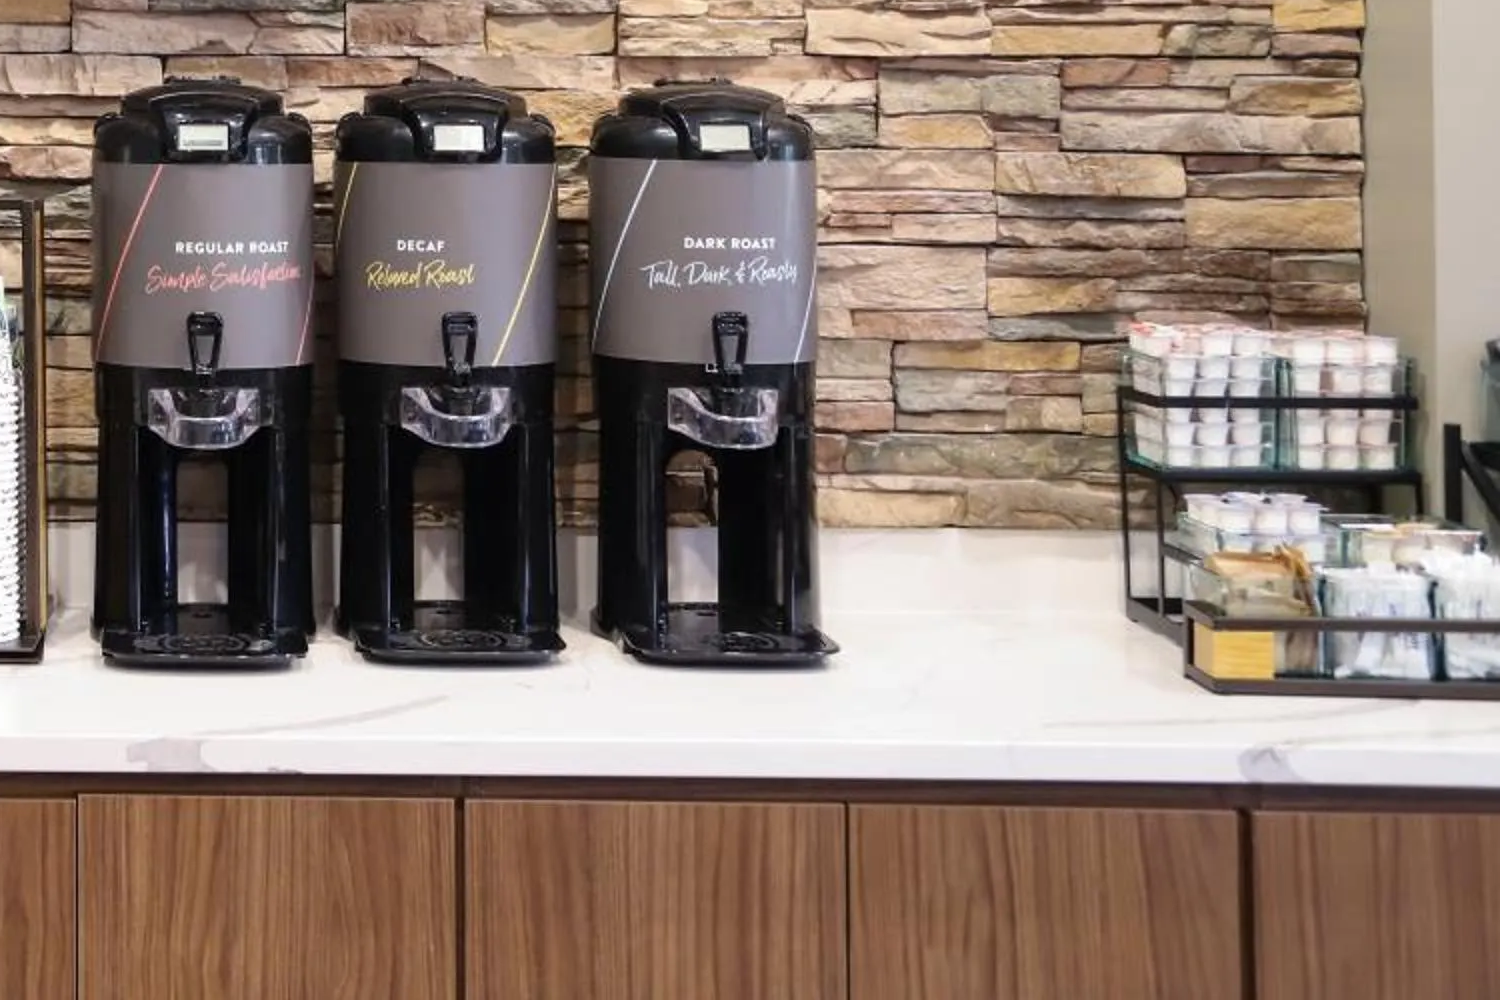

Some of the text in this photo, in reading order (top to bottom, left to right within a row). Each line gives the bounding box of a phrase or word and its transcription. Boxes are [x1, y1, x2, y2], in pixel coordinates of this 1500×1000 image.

[175, 241, 289, 254] REGULAR ROAST
[397, 239, 445, 252] DECAF
[684, 237, 775, 249] DARK ROAST
[145, 265, 206, 294] Simple
[423, 259, 475, 289] Roast
[682, 261, 732, 286] Dark
